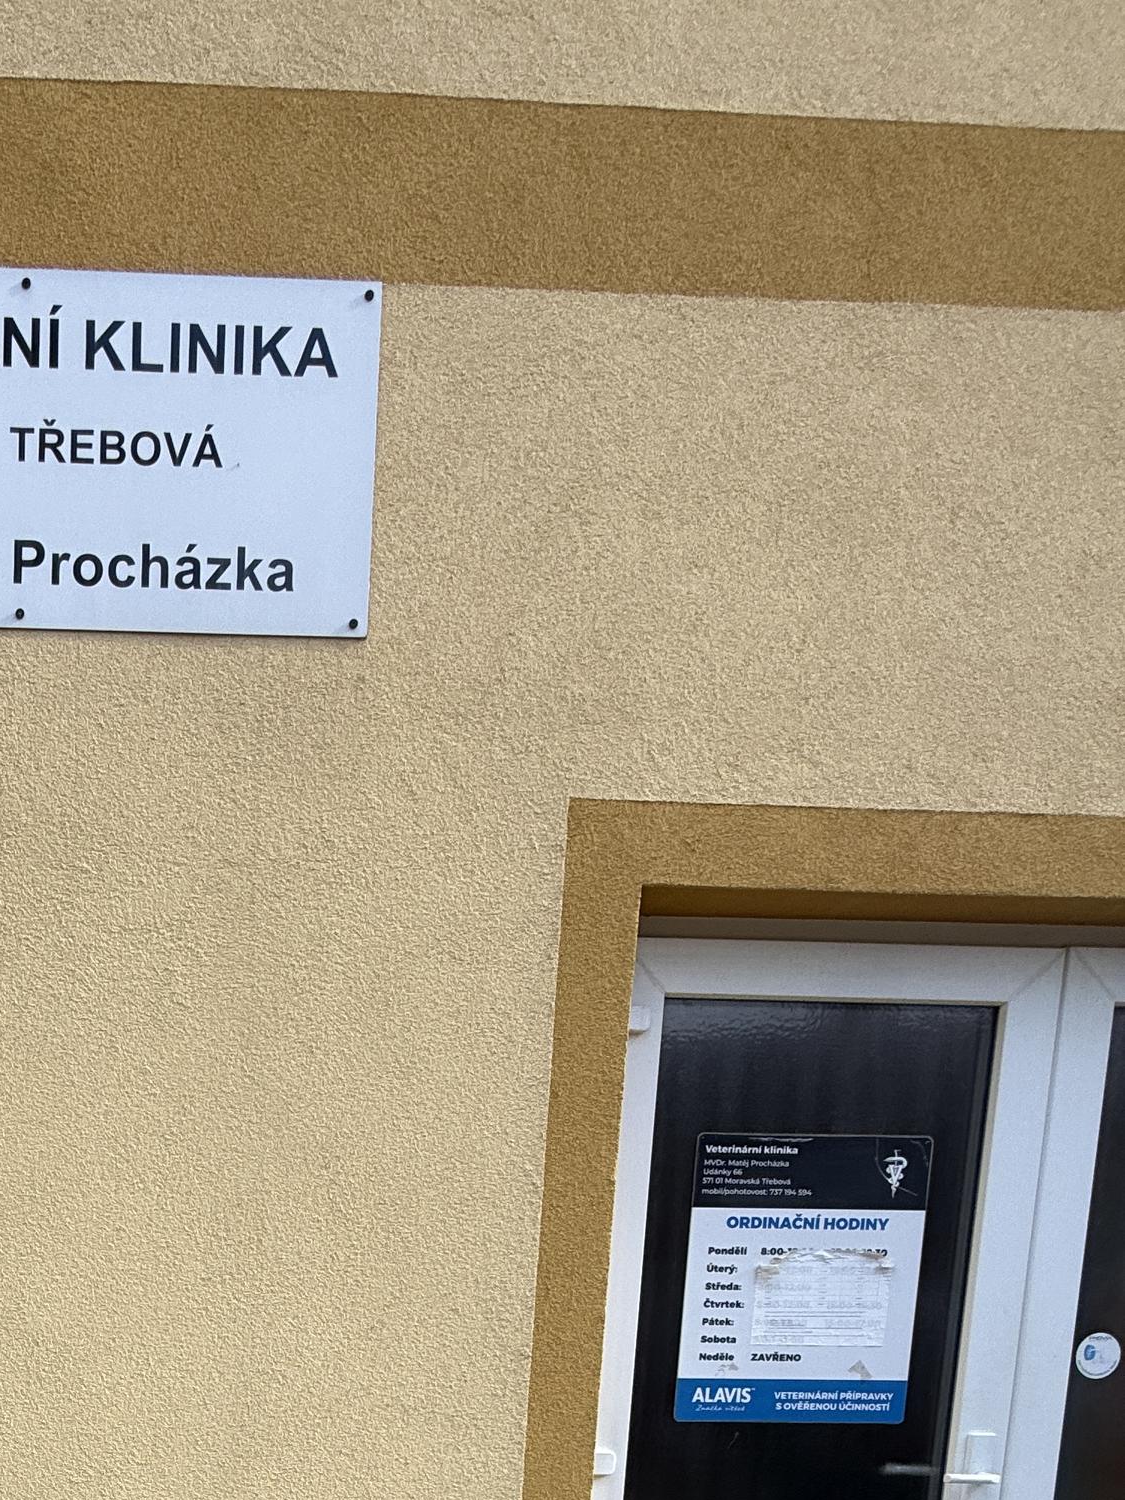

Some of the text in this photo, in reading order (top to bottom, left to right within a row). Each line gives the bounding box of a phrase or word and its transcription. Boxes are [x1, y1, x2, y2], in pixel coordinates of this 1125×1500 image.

[84, 320, 339, 379] KLINIKA
[10, 419, 222, 468] TŘEBOVÁ
[12, 539, 294, 592] Procházka
[705, 1144, 799, 1155] Veterinární klinika
[728, 1159, 749, 1168] Matěj
[751, 1159, 790, 1167] Procházka
[703, 1168, 732, 1176] Udánky
[762, 1177, 791, 1185] Třebová
[726, 1214, 889, 1231] ORDINAČNÍ HODINY
[707, 1246, 747, 1256] Pondělí
[706, 1262, 738, 1275] Úterý:
[705, 1282, 742, 1291] Středa:
[703, 1298, 745, 1309] Čtvrtek:
[702, 1317, 734, 1326] Pátek:
[700, 1335, 737, 1344] Sobota
[699, 1351, 802, 1362] Neděle ZAVŘENO
[774, 1390, 894, 1401] VETERINÁRNÍ PŘÍPRAVKY
[775, 1401, 890, 1412] S OVĚŘENOU ÚČINNOSTÍ
